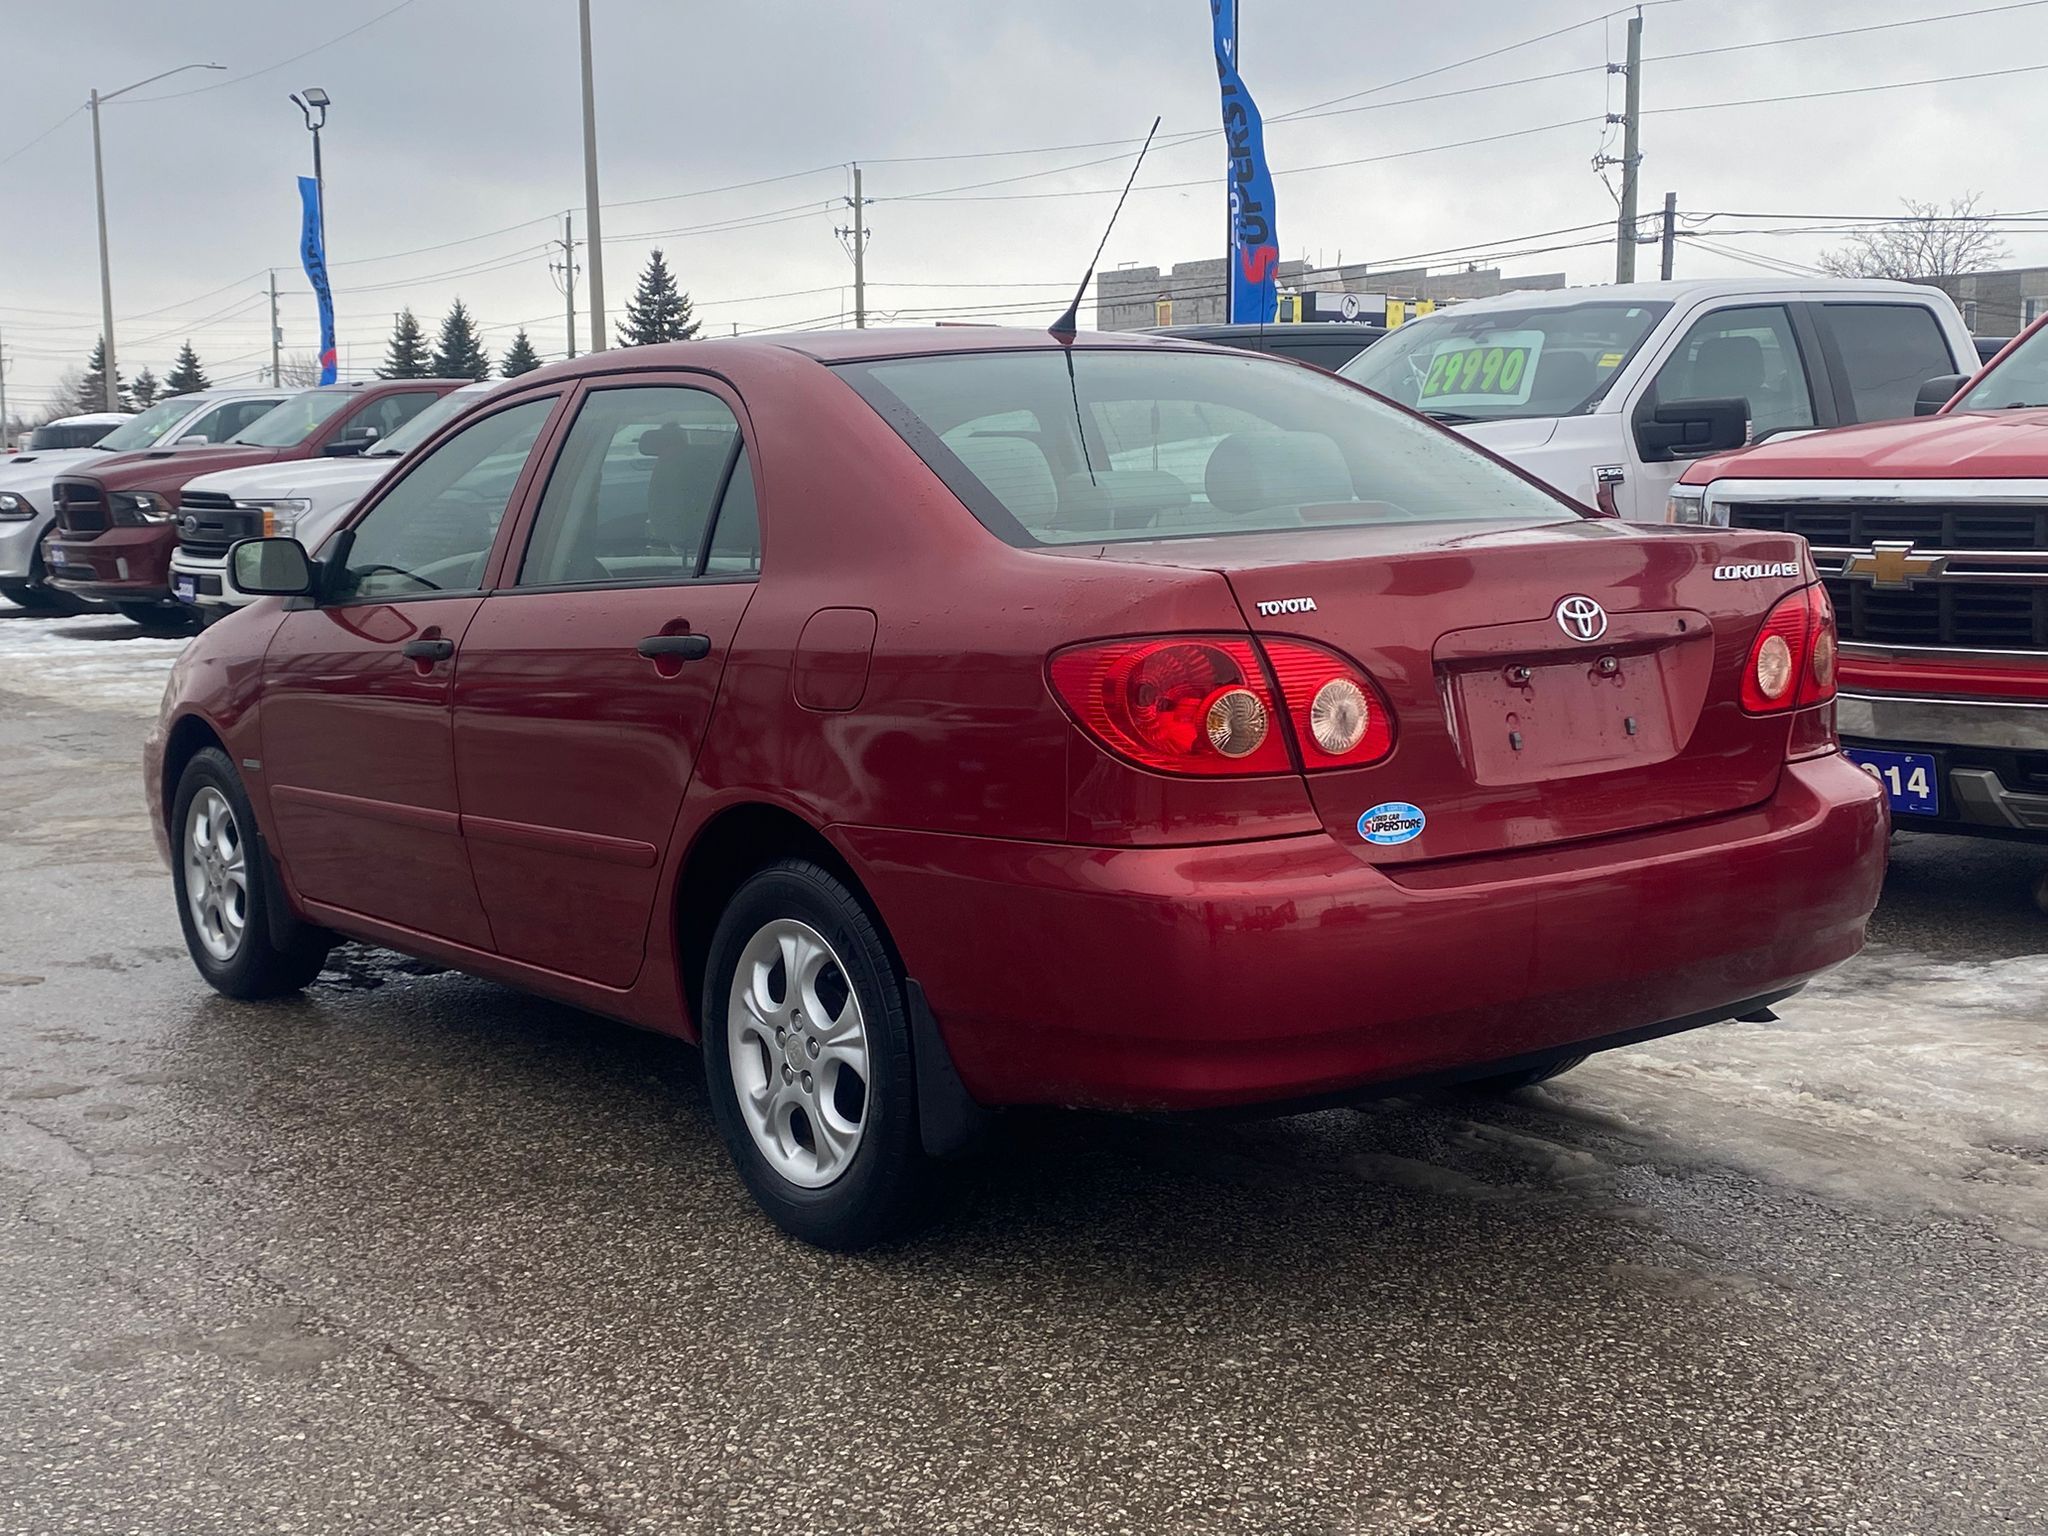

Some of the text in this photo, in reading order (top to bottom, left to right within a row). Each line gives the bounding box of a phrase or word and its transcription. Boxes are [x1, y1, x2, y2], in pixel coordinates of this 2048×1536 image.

[1423, 347, 1525, 397] 29990
[1713, 564, 1781, 580] COROLLA
[1256, 597, 1318, 616] TOYOTA
[1388, 813, 1400, 821] CAR
[1364, 818, 1422, 835] SUPERSTORE
